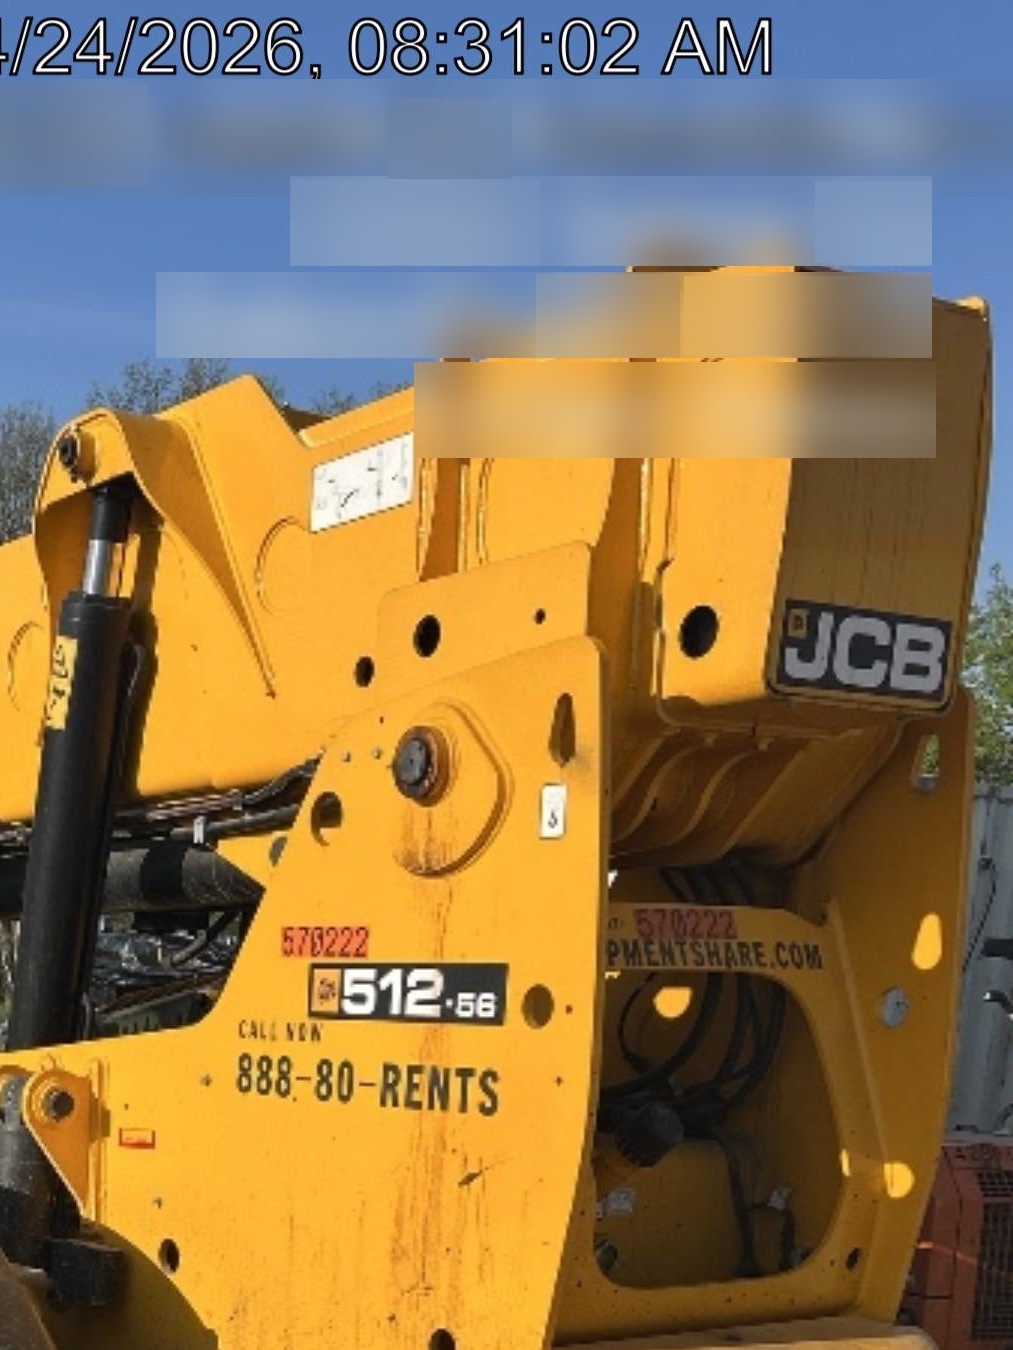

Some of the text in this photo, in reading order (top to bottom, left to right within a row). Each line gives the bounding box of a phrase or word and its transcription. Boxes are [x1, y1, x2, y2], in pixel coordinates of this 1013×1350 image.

[784, 611, 945, 694] JCB
[633, 908, 739, 940] 570222
[282, 925, 370, 958] 570222
[238, 1019, 324, 1042] CALL NOW
[237, 1052, 500, 1117] 888-80-RENTS
